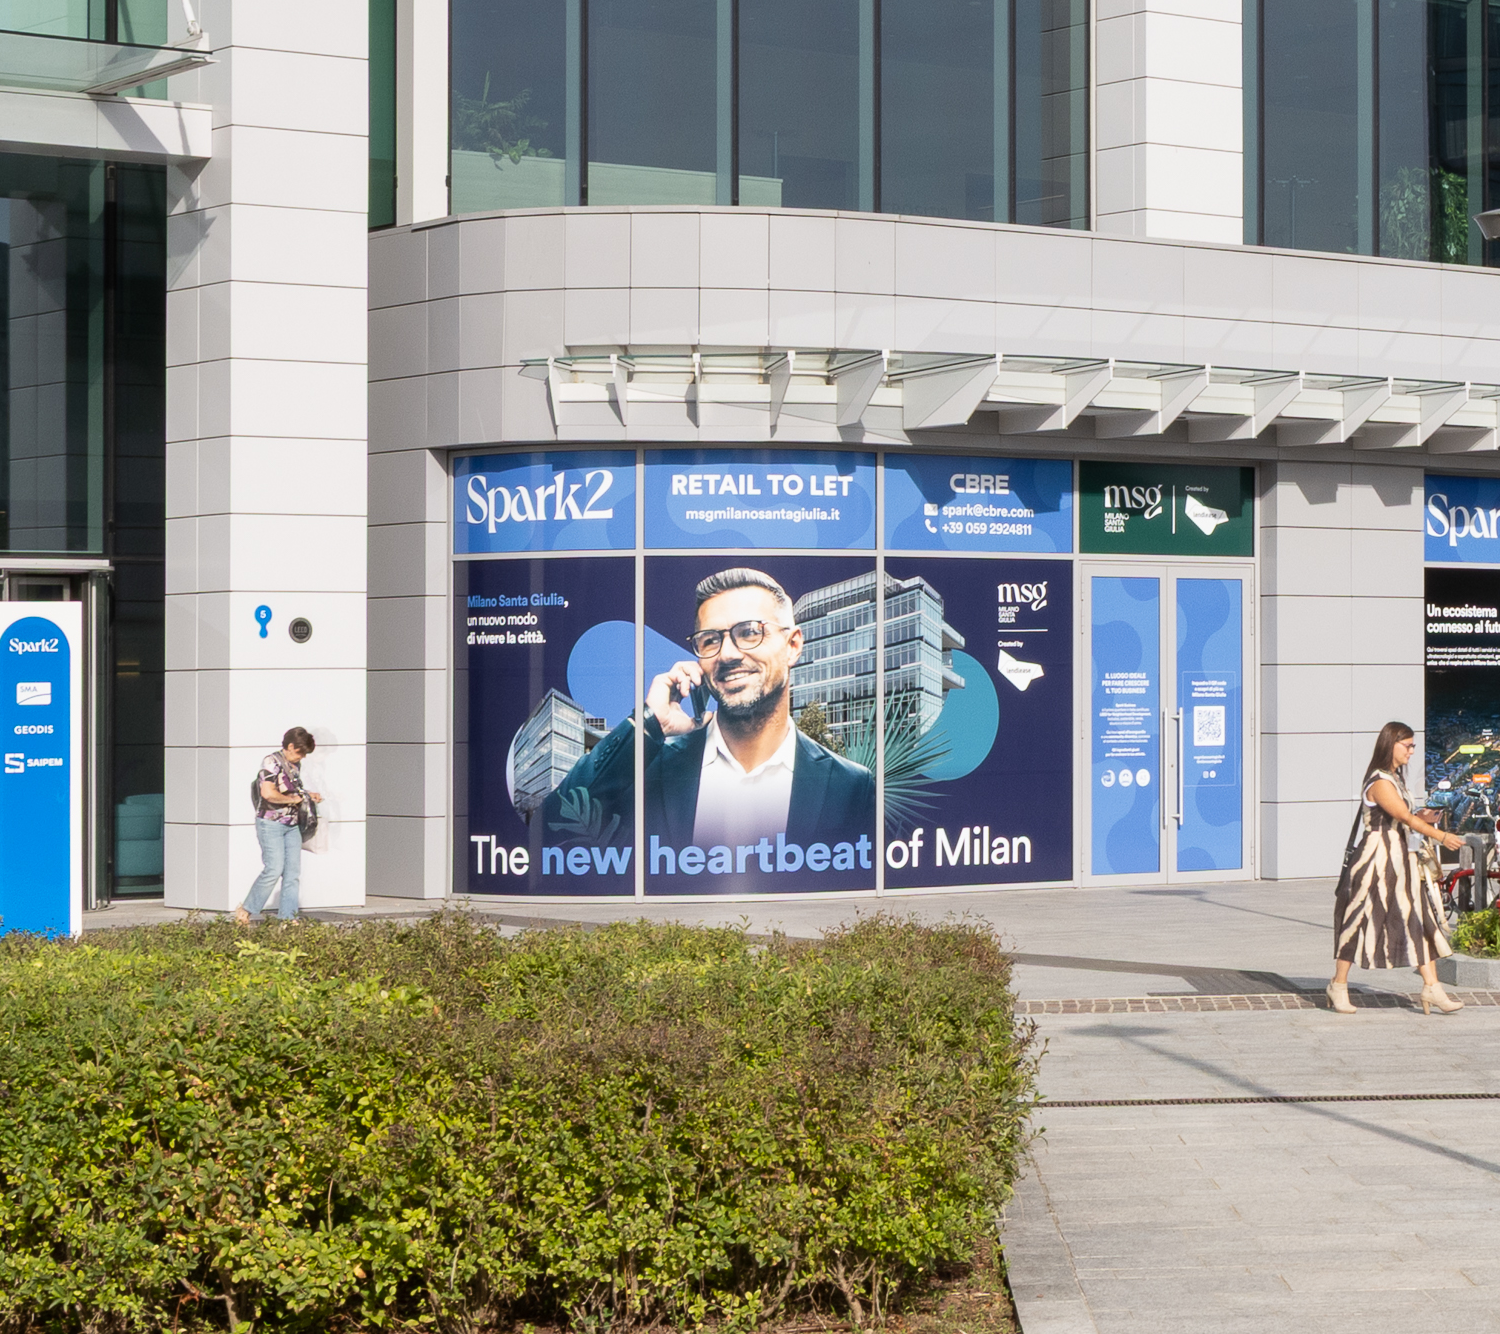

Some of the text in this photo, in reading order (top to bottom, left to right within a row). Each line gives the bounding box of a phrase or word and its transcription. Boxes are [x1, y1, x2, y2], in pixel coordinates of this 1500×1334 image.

[671, 474, 853, 496] RETAIL TO LET
[949, 473, 1010, 495] CBRE
[466, 469, 613, 534] Spark2
[1103, 483, 1163, 520] msg
[685, 507, 840, 522] msgmilanosantagiulia.it
[942, 503, 1035, 518] spark@cbre.com
[1104, 512, 1129, 520] MILANO
[942, 522, 1032, 536] +39 059 2924811
[467, 592, 569, 609] Milano Santa Giulia,
[997, 581, 1048, 612] msg
[260, 609, 267, 619] 5
[1426, 603, 1498, 618] Un ecosistema
[467, 612, 538, 626] un nuovo modo
[1426, 622, 1474, 634] connesso
[1474, 619, 1484, 633] al
[467, 630, 547, 645] di vivere la città.
[8, 637, 59, 655] Spark2
[19, 685, 38, 693] SMA
[13, 725, 54, 734] GEODIS
[26, 757, 63, 767] SAIPEM
[471, 827, 1032, 876] The new heartbeat of Milan
